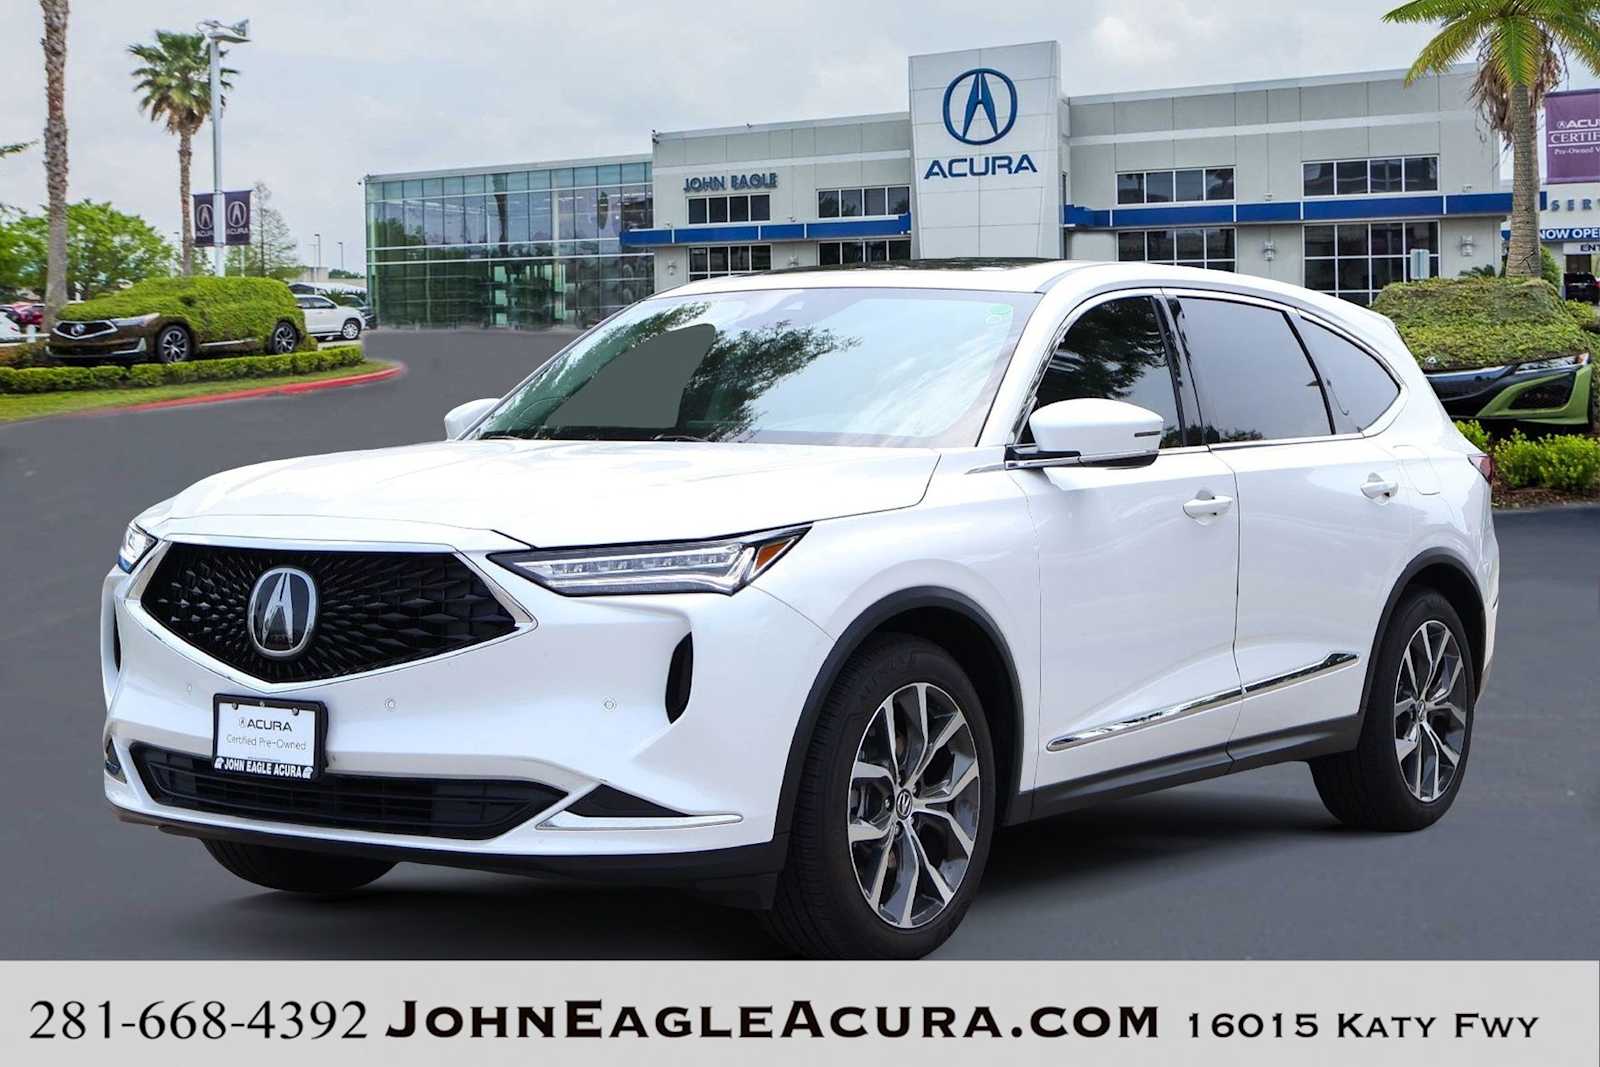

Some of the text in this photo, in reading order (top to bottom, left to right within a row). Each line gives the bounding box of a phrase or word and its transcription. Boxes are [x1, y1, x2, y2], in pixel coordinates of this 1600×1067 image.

[1566, 118, 1600, 128] ACU
[923, 153, 1038, 180] ACURA
[683, 172, 777, 192] JOHN EAGLE
[1551, 197, 1600, 212] SER
[225, 227, 249, 235] ACURA
[1572, 228, 1600, 239] OPE
[247, 719, 292, 732] ACURA
[226, 734, 307, 751] Certified Pre-Owned
[224, 758, 245, 772] JOHN
[246, 760, 272, 775] EAGLE
[273, 763, 301, 778] ACURA
